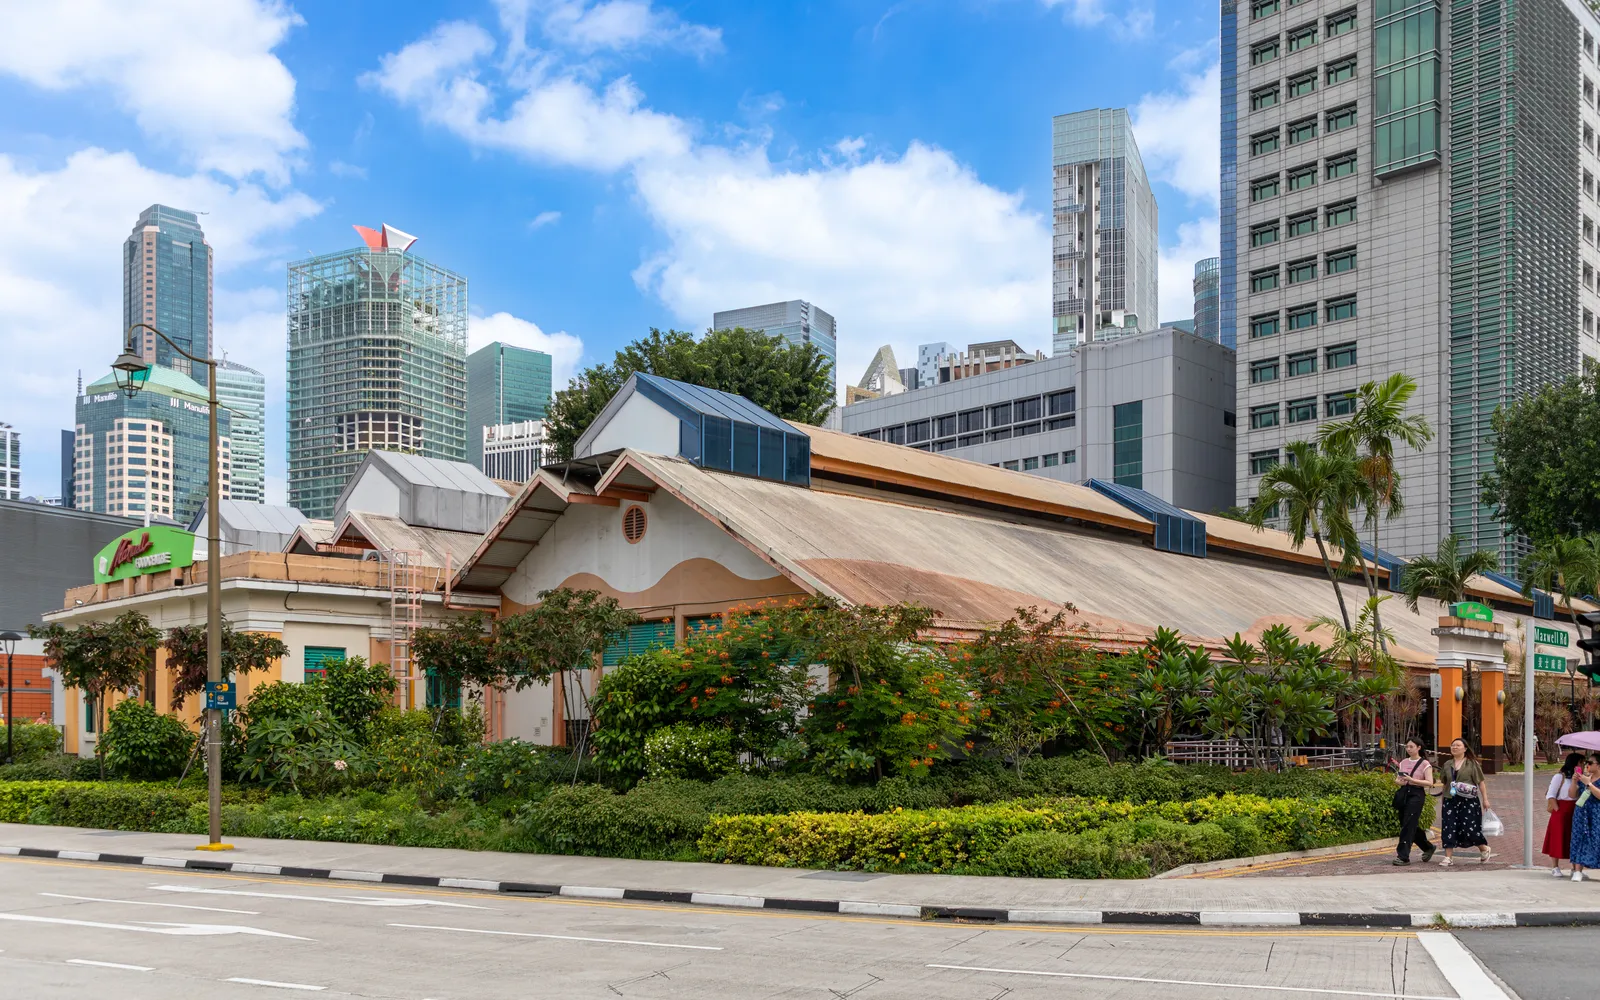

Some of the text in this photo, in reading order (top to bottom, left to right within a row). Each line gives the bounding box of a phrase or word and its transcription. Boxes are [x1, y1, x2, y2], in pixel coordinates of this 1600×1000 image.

[184, 402, 210, 414] Manulif
[1534, 628, 1567, 645] Maxwell Rd
